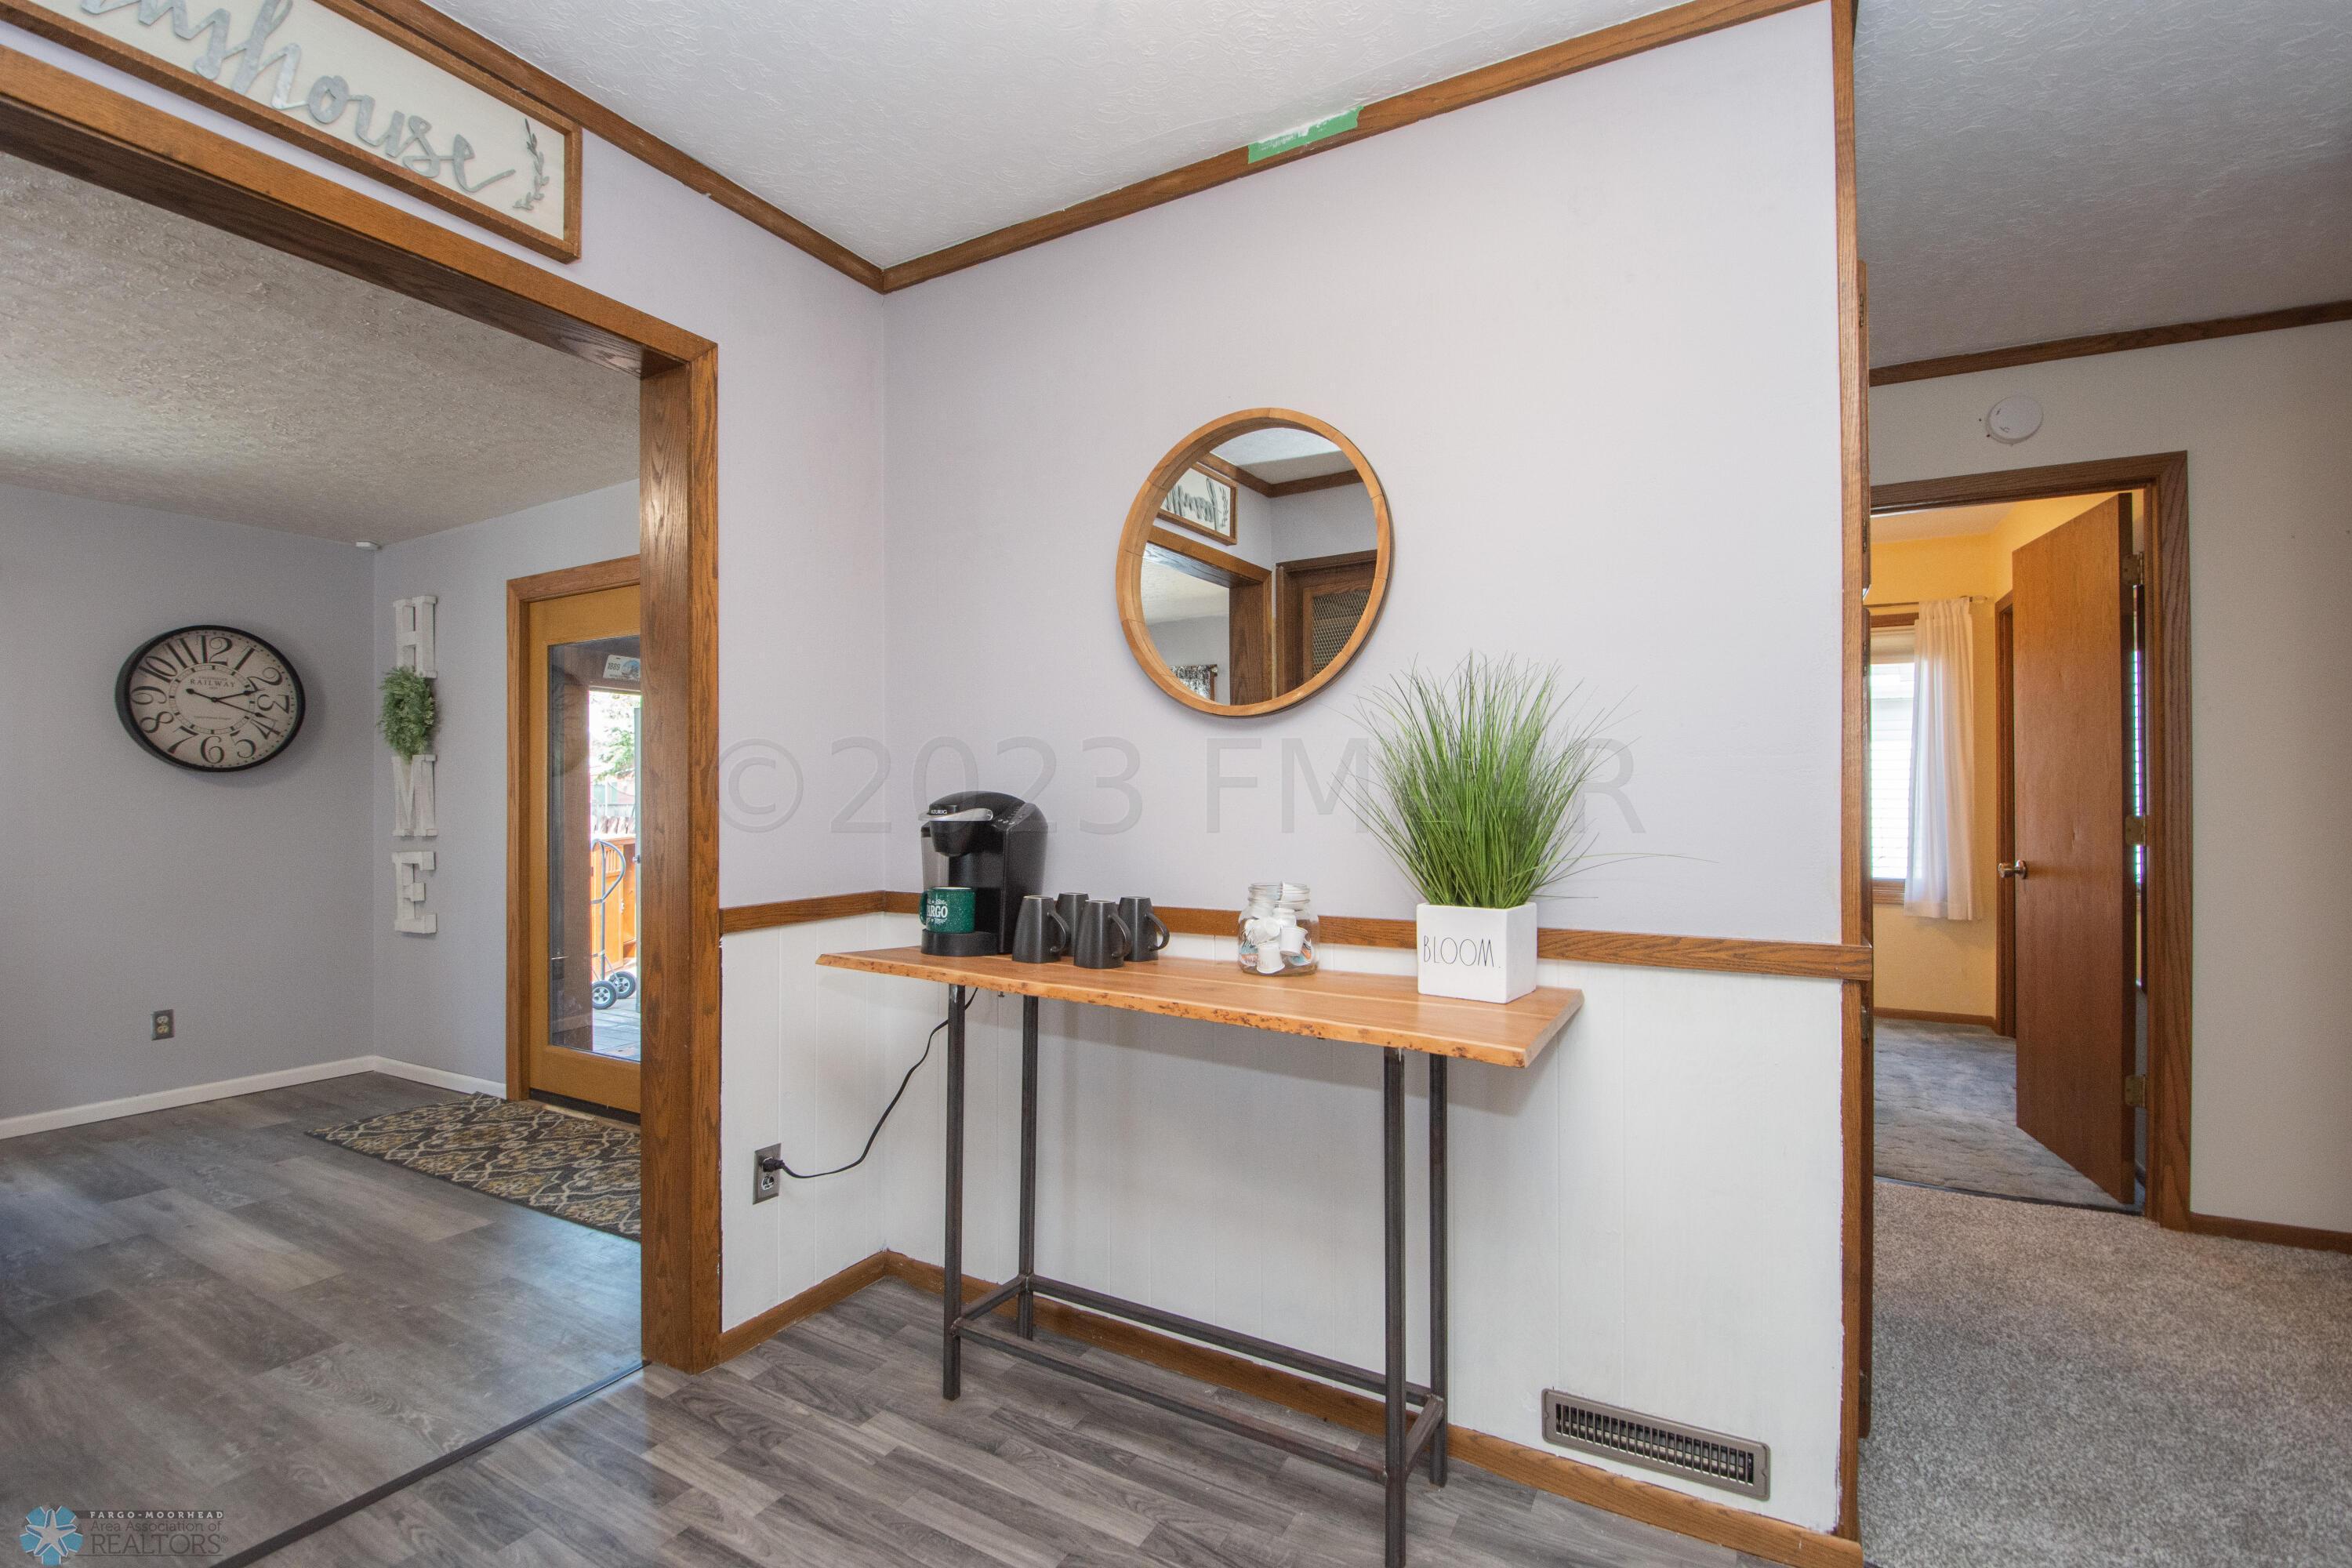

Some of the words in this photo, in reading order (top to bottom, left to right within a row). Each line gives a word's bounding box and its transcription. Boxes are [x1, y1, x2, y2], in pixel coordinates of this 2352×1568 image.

[163, 637, 199, 669] 11
[200, 635, 233, 666] 12
[234, 645, 260, 671] 1
[138, 656, 177, 683] 10
[248, 666, 283, 691] 2
[130, 686, 168, 705] 9
[190, 678, 235, 688] RAILWAY
[256, 694, 290, 714] 3
[140, 711, 174, 733] 8
[249, 717, 281, 740] 4
[168, 725, 199, 754] 7
[200, 735, 225, 764] 6
[230, 731, 256, 759] 5
